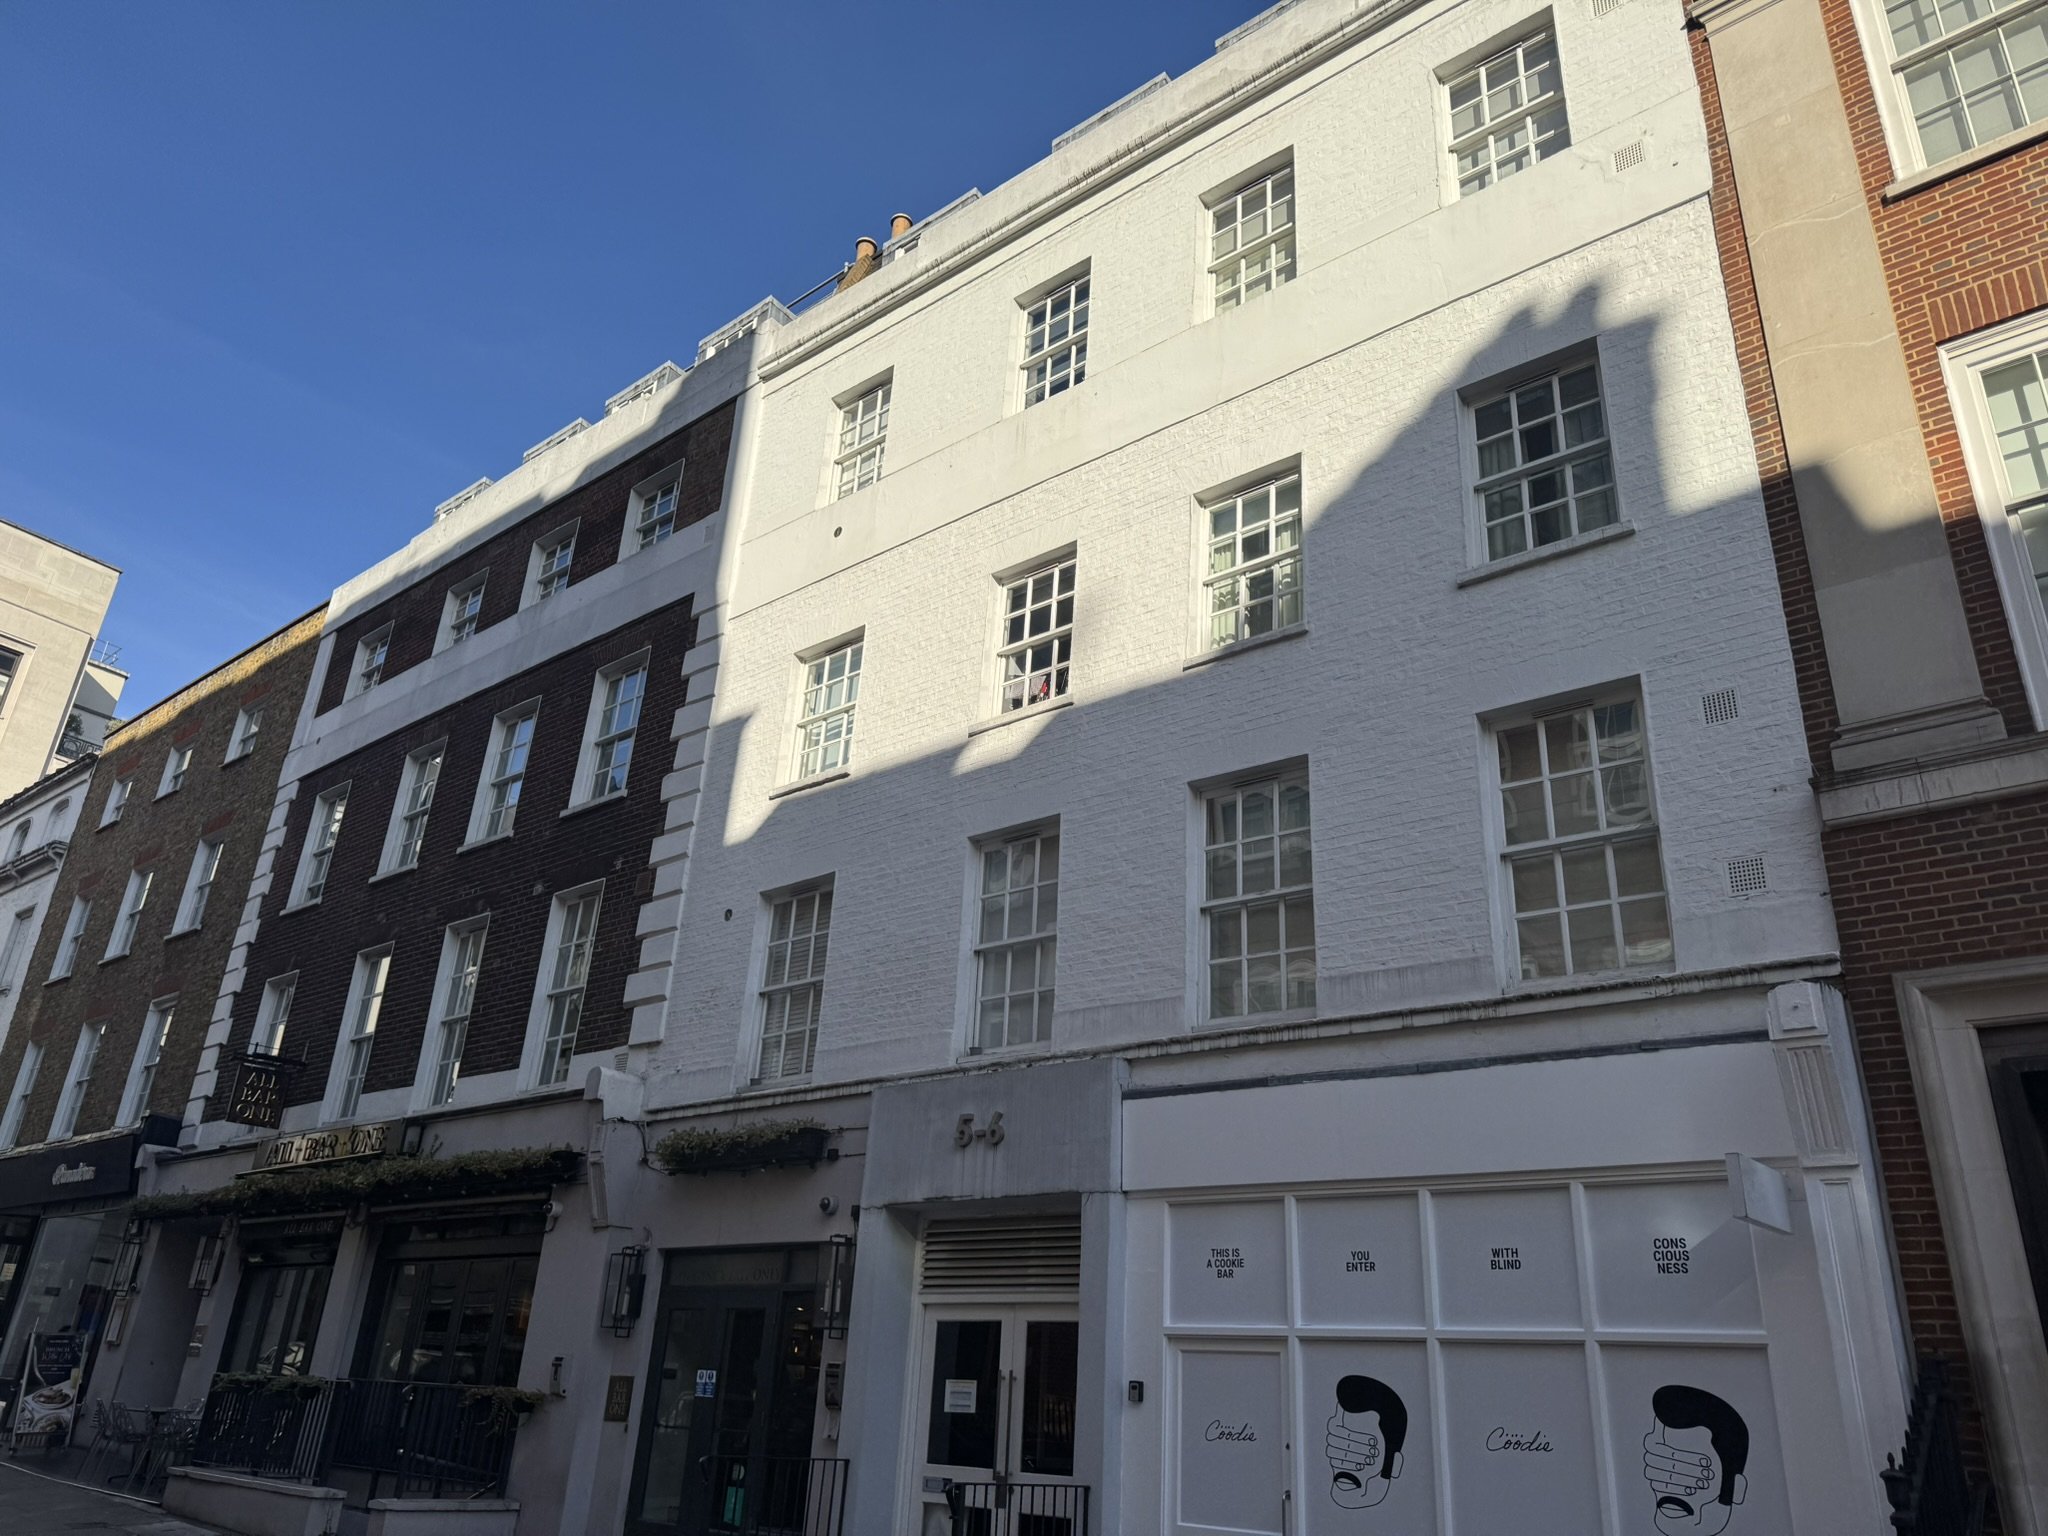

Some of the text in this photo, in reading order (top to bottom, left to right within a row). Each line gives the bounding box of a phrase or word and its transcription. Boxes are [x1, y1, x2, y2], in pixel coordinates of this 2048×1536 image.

[247, 1071, 279, 1089] ALL
[241, 1087, 277, 1105] BAR
[236, 1103, 275, 1122] ONE
[954, 1111, 1005, 1151] 5-6
[264, 1126, 390, 1165] ALL BAR ONE
[1654, 1238, 1687, 1249] CONS
[1211, 1248, 1240, 1258] THIS IS
[1351, 1251, 1370, 1261] YOU
[1491, 1248, 1519, 1258] WITH
[1653, 1250, 1690, 1262] CIOUS
[1206, 1258, 1245, 1269] A COOKIE
[1346, 1262, 1376, 1272] ENTER
[1491, 1259, 1522, 1270] BLIND
[1657, 1263, 1689, 1274] NESS
[1216, 1268, 1234, 1279] BAR
